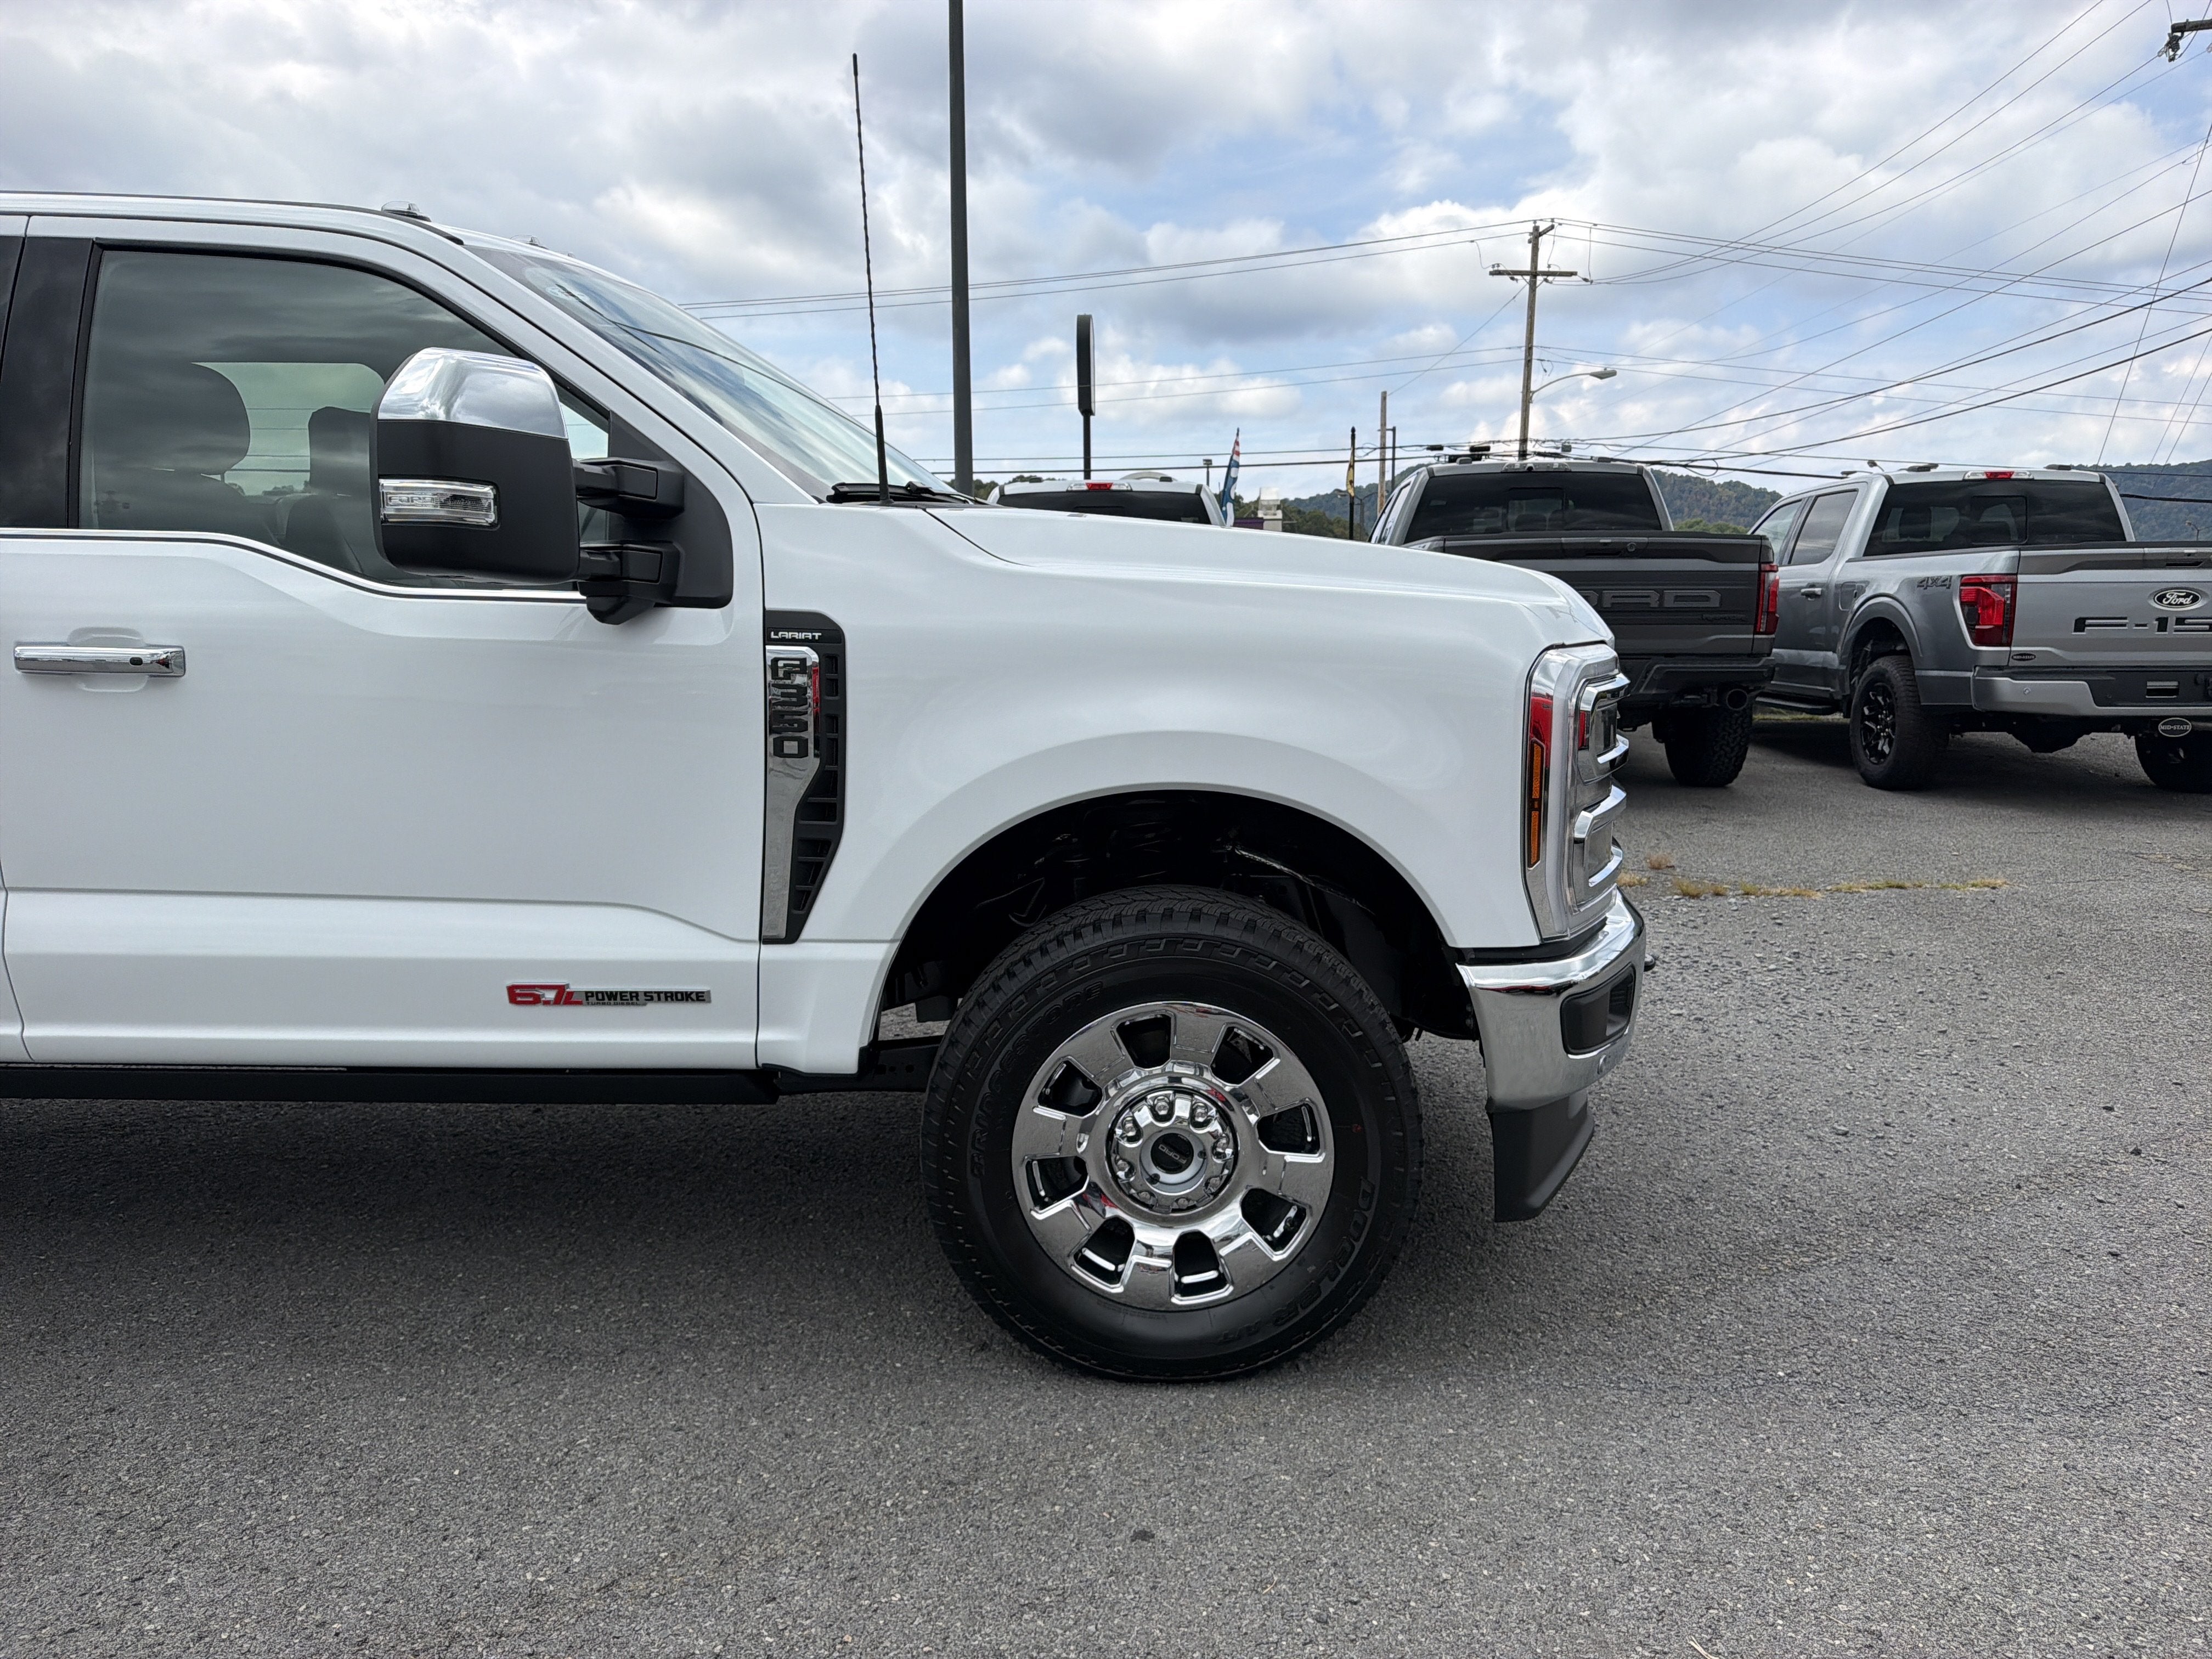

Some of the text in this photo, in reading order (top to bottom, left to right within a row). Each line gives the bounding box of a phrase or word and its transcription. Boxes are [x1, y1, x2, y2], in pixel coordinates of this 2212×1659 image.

[2162, 591, 2194, 605] Ford
[770, 631, 822, 640] LARIAT
[506, 983, 706, 1005] 6.7L POWER STROKE
[970, 980, 1104, 1178] BRIDGESTONE
[1158, 1143, 1187, 1164] FORD
